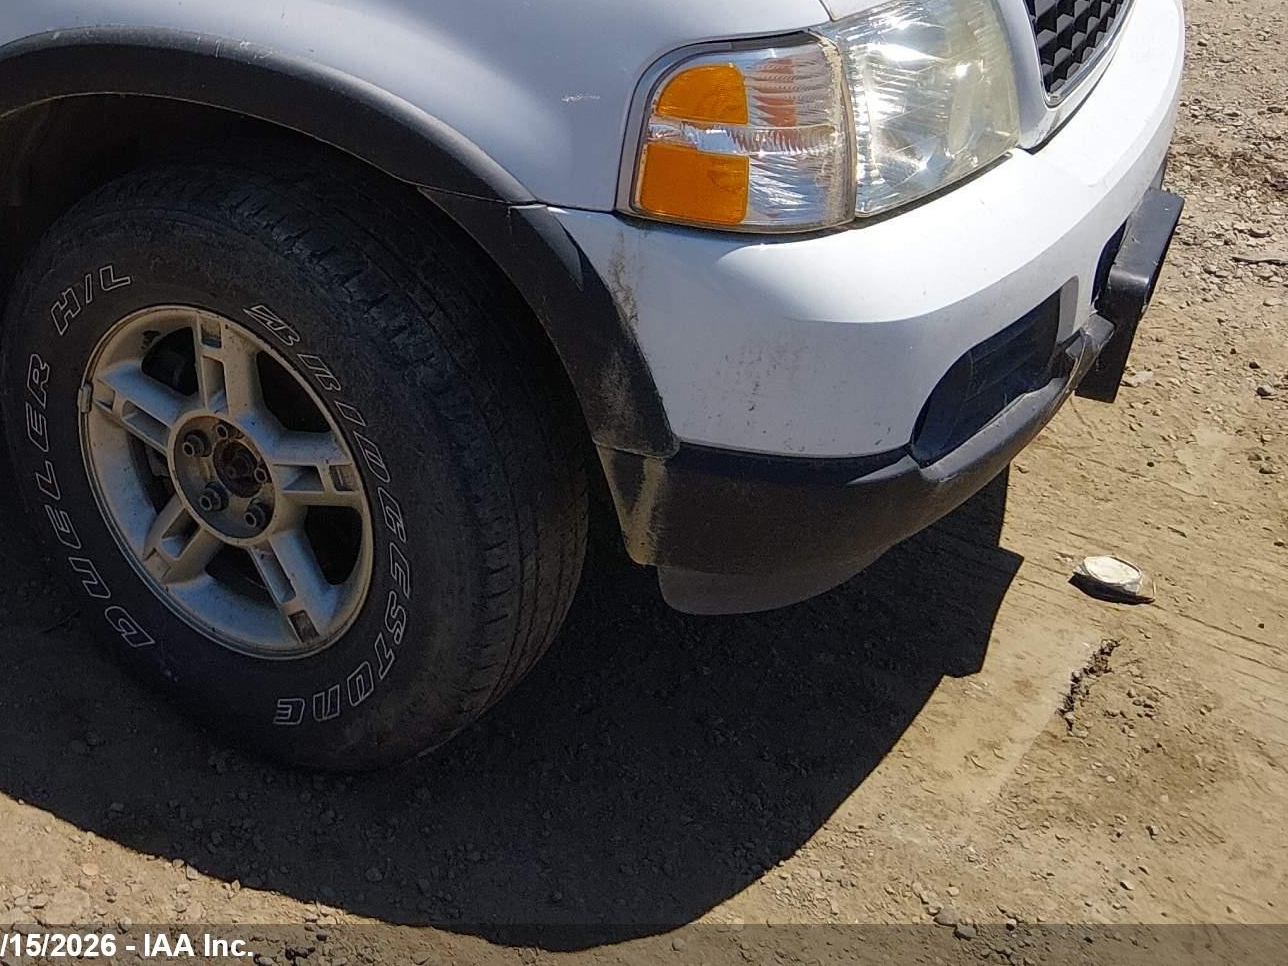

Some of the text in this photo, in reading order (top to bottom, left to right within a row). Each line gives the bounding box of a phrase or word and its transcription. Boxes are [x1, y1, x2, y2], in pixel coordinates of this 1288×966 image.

[25, 265, 155, 647] DUELER H/L
[243, 304, 411, 726] BRIDGESTONE
